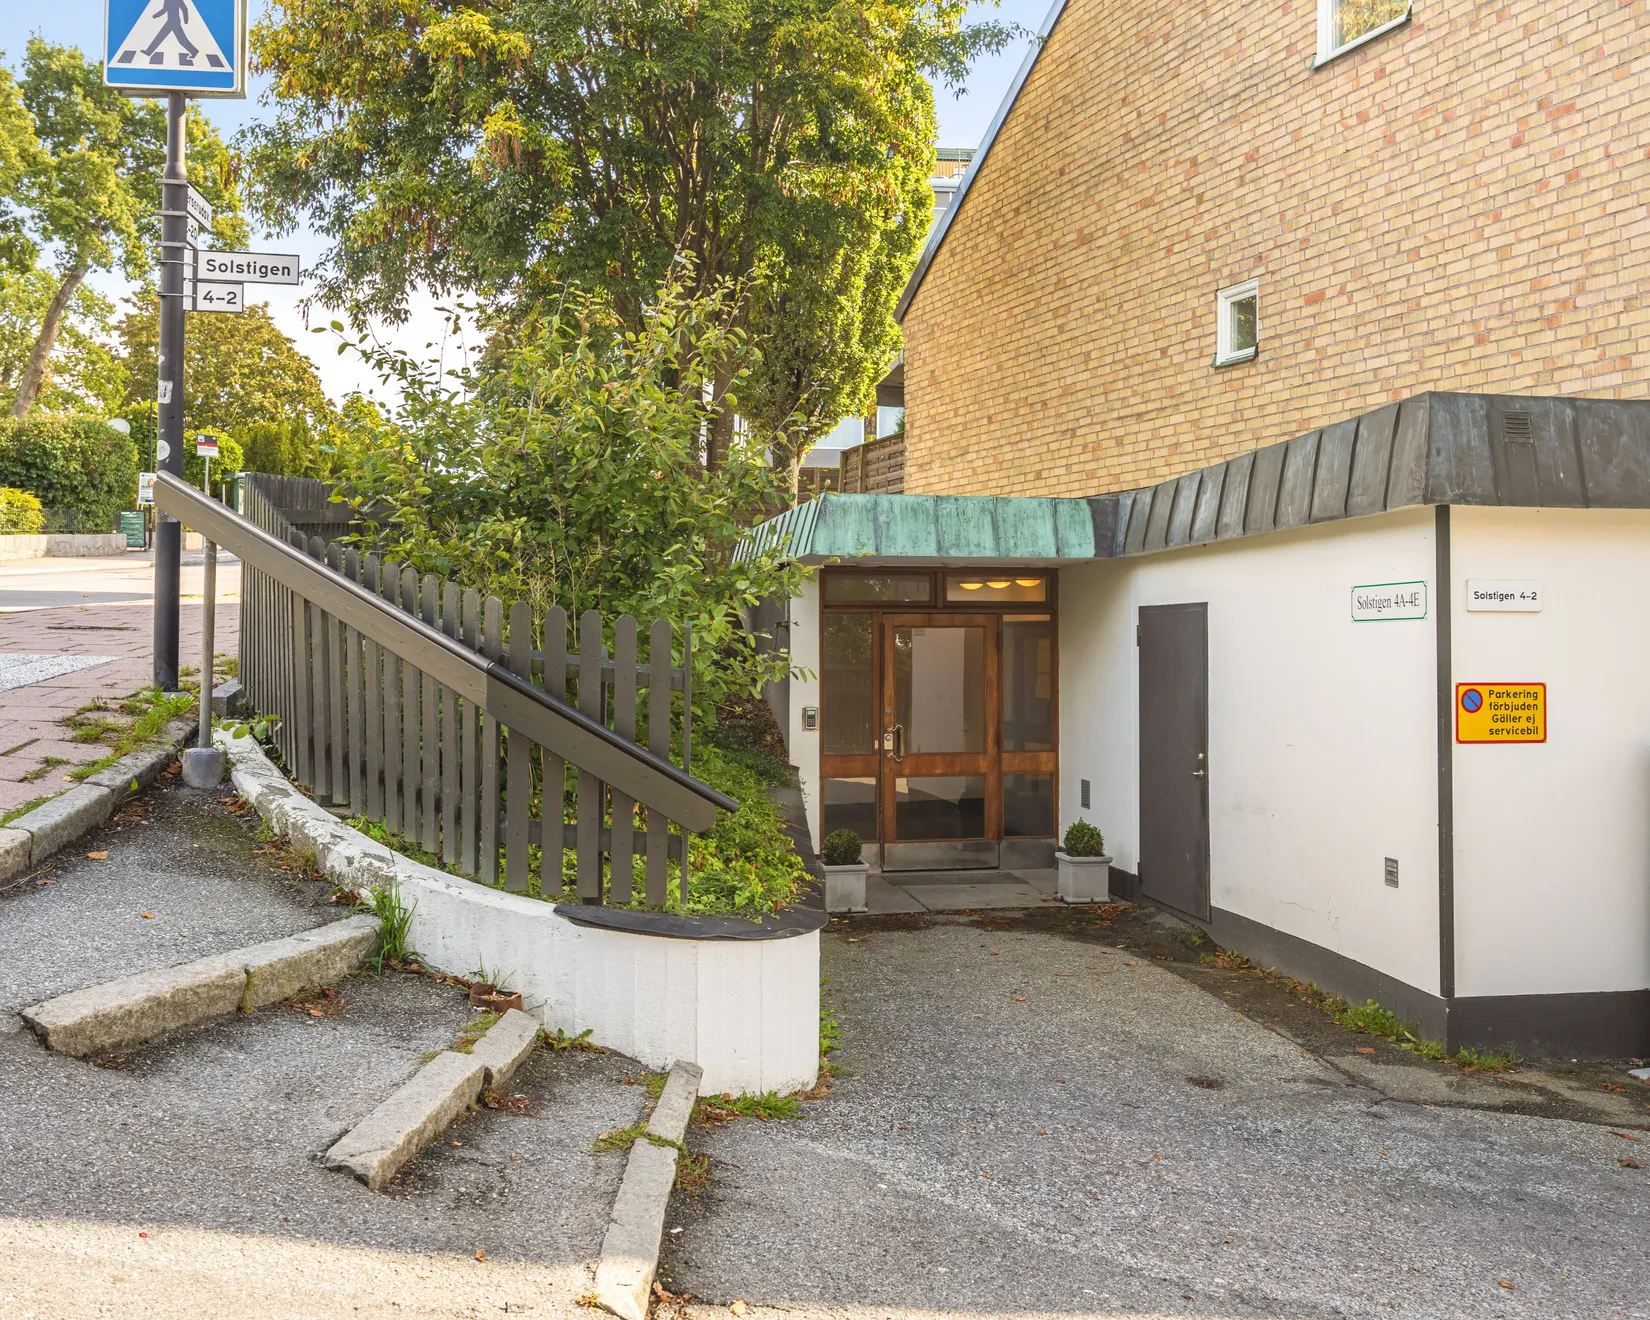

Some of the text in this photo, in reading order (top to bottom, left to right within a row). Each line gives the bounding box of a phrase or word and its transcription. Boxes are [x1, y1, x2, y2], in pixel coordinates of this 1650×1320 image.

[206, 258, 291, 279] Solstigen
[1473, 590, 1515, 602] Solstigen
[1356, 592, 1420, 613] Solstigen 4A-4E
[1488, 689, 1538, 701] Parkering
[1489, 701, 1538, 713] förbjuden
[1491, 713, 1536, 725] Gäller ej
[1488, 725, 1539, 736] servicebil
